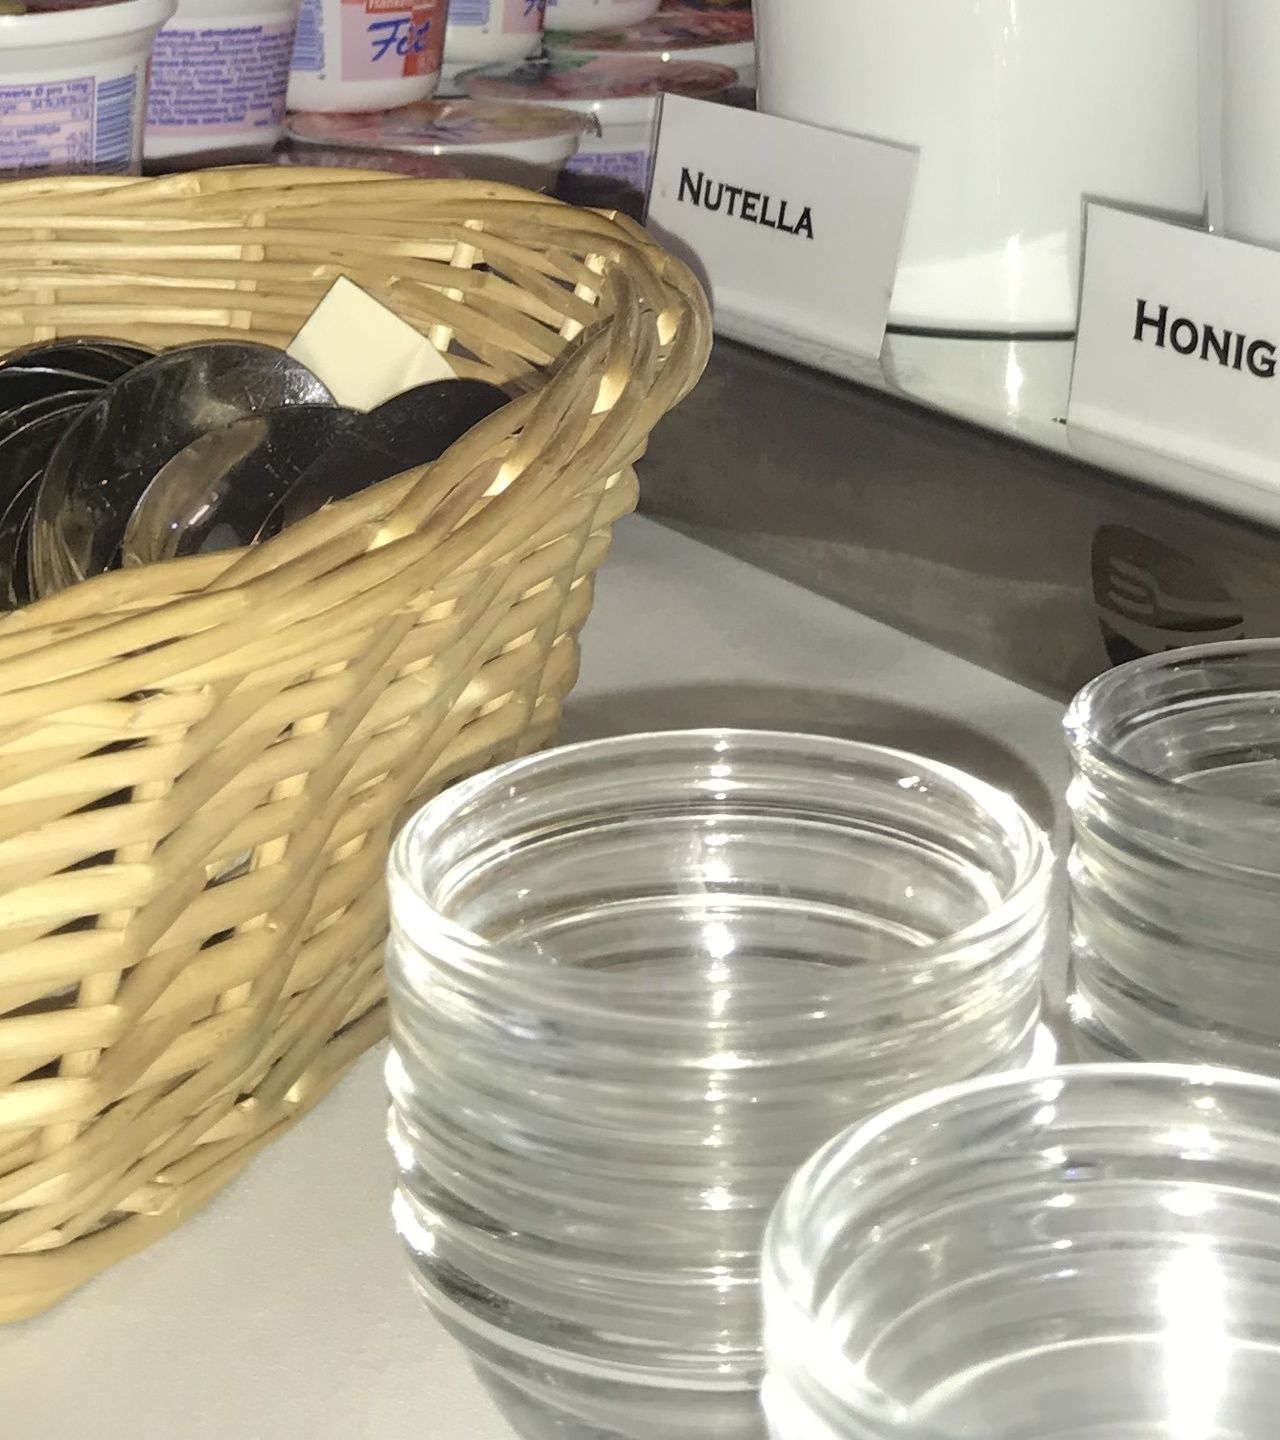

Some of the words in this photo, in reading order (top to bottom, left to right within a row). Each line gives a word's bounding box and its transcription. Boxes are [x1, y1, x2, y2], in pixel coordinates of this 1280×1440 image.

[367, 17, 431, 62] Fit
[677, 167, 814, 241] NUTELLA
[1133, 298, 1278, 379] HONIG
